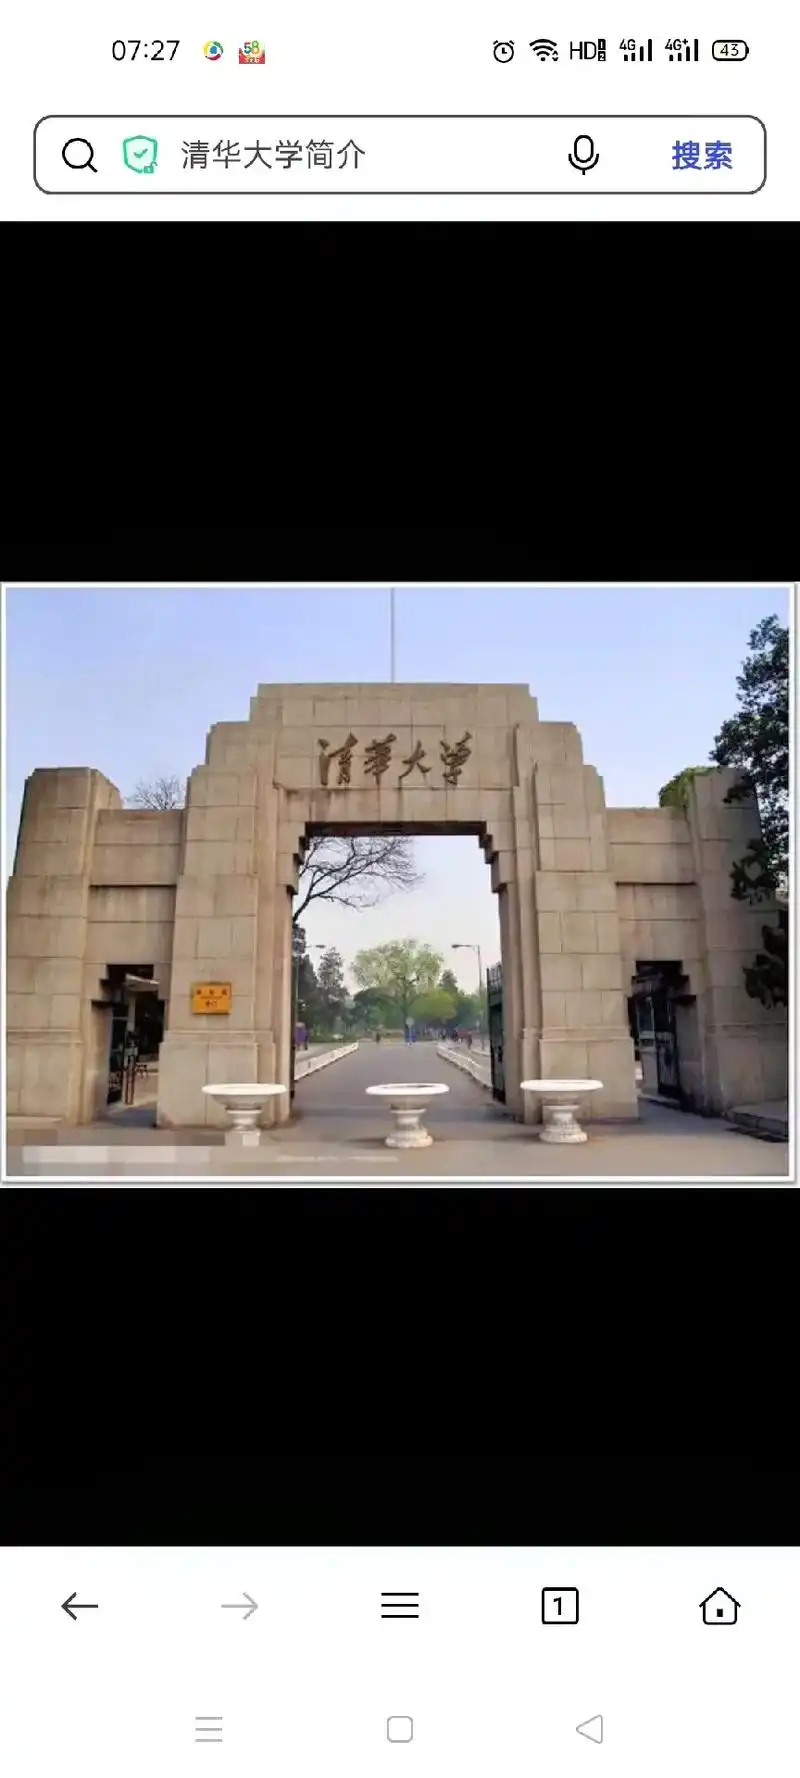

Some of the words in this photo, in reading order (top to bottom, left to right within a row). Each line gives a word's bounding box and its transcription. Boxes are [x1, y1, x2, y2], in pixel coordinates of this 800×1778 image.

[111, 39, 181, 62] 07:27
[243, 40, 260, 54] 58
[619, 38, 636, 51] 4G
[719, 43, 740, 57] 43
[181, 138, 366, 170] 清华大学简介
[671, 139, 733, 171] 搜索
[553, 1596, 562, 1616] 1
